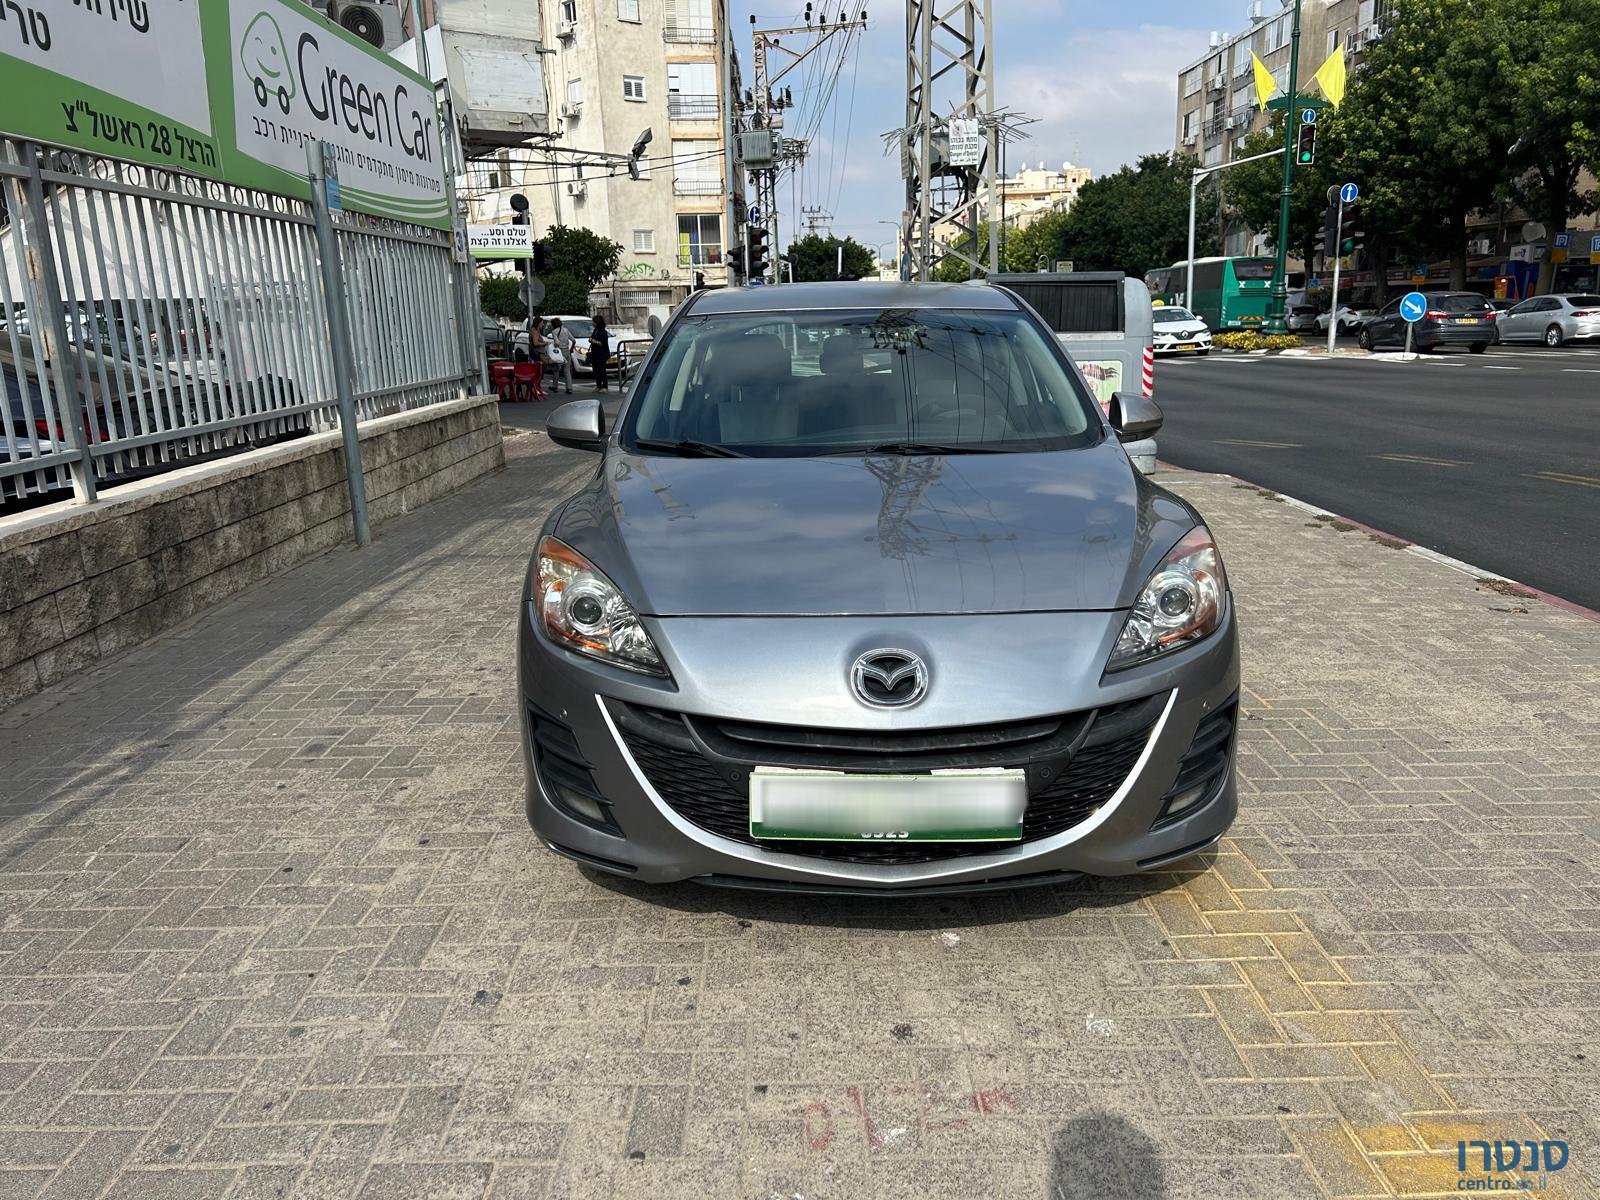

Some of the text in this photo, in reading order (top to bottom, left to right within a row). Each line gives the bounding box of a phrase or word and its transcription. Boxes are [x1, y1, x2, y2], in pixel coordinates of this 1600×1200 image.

[297, 32, 432, 163] Green Car
[148, 121, 172, 156] 28
[252, 115, 277, 141] רכב
[174, 127, 216, 168] הרצל
[357, 153, 394, 179] מתקדמים
[395, 166, 414, 185] מימון
[416, 173, 441, 193] פתרונות
[470, 237, 527, 247] אצלנו זה קצת
[507, 228, 526, 236] שלם
